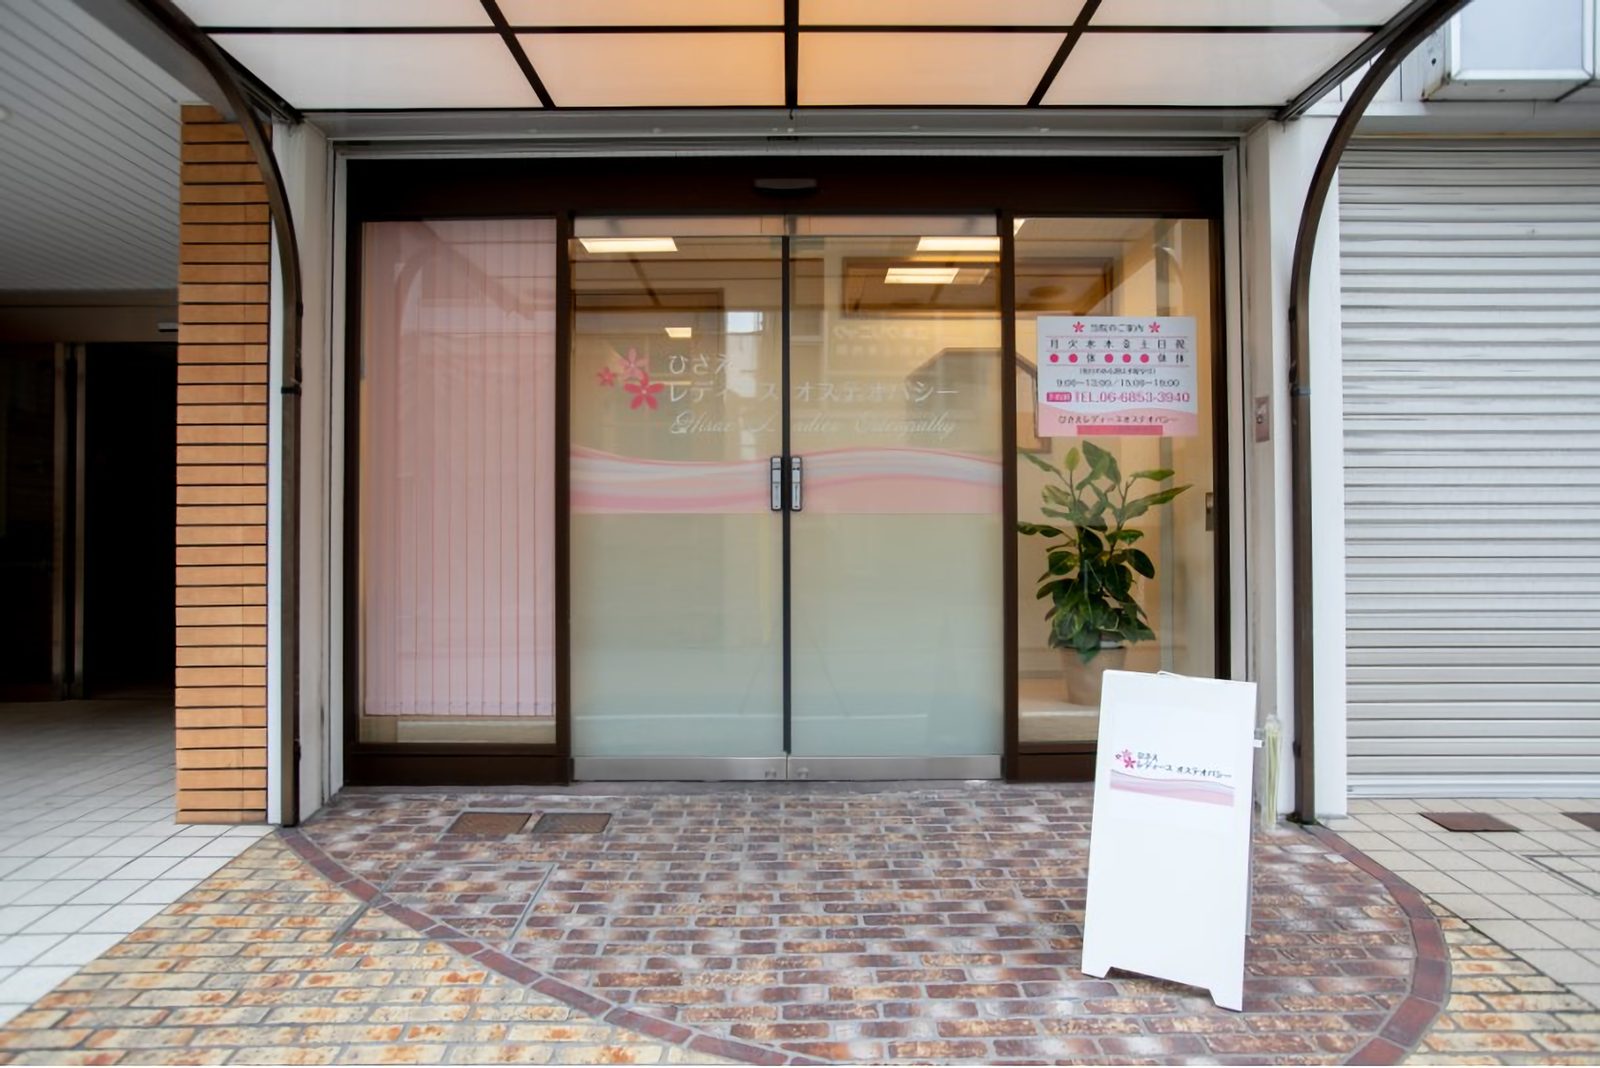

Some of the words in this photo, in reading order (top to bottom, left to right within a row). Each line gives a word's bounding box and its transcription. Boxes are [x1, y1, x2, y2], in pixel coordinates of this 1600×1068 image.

[1050, 339, 1059, 349] 月
[1068, 339, 1078, 349] 火
[1087, 339, 1096, 349] 水
[1105, 339, 1114, 349] 木
[1123, 339, 1131, 349] 金
[1141, 339, 1150, 349] 土
[1157, 339, 1166, 349] 日
[1175, 339, 1185, 349] 祝
[1087, 353, 1096, 363] 休
[1157, 353, 1166, 363] 休
[1175, 353, 1184, 363] 休
[669, 380, 780, 402] レディス
